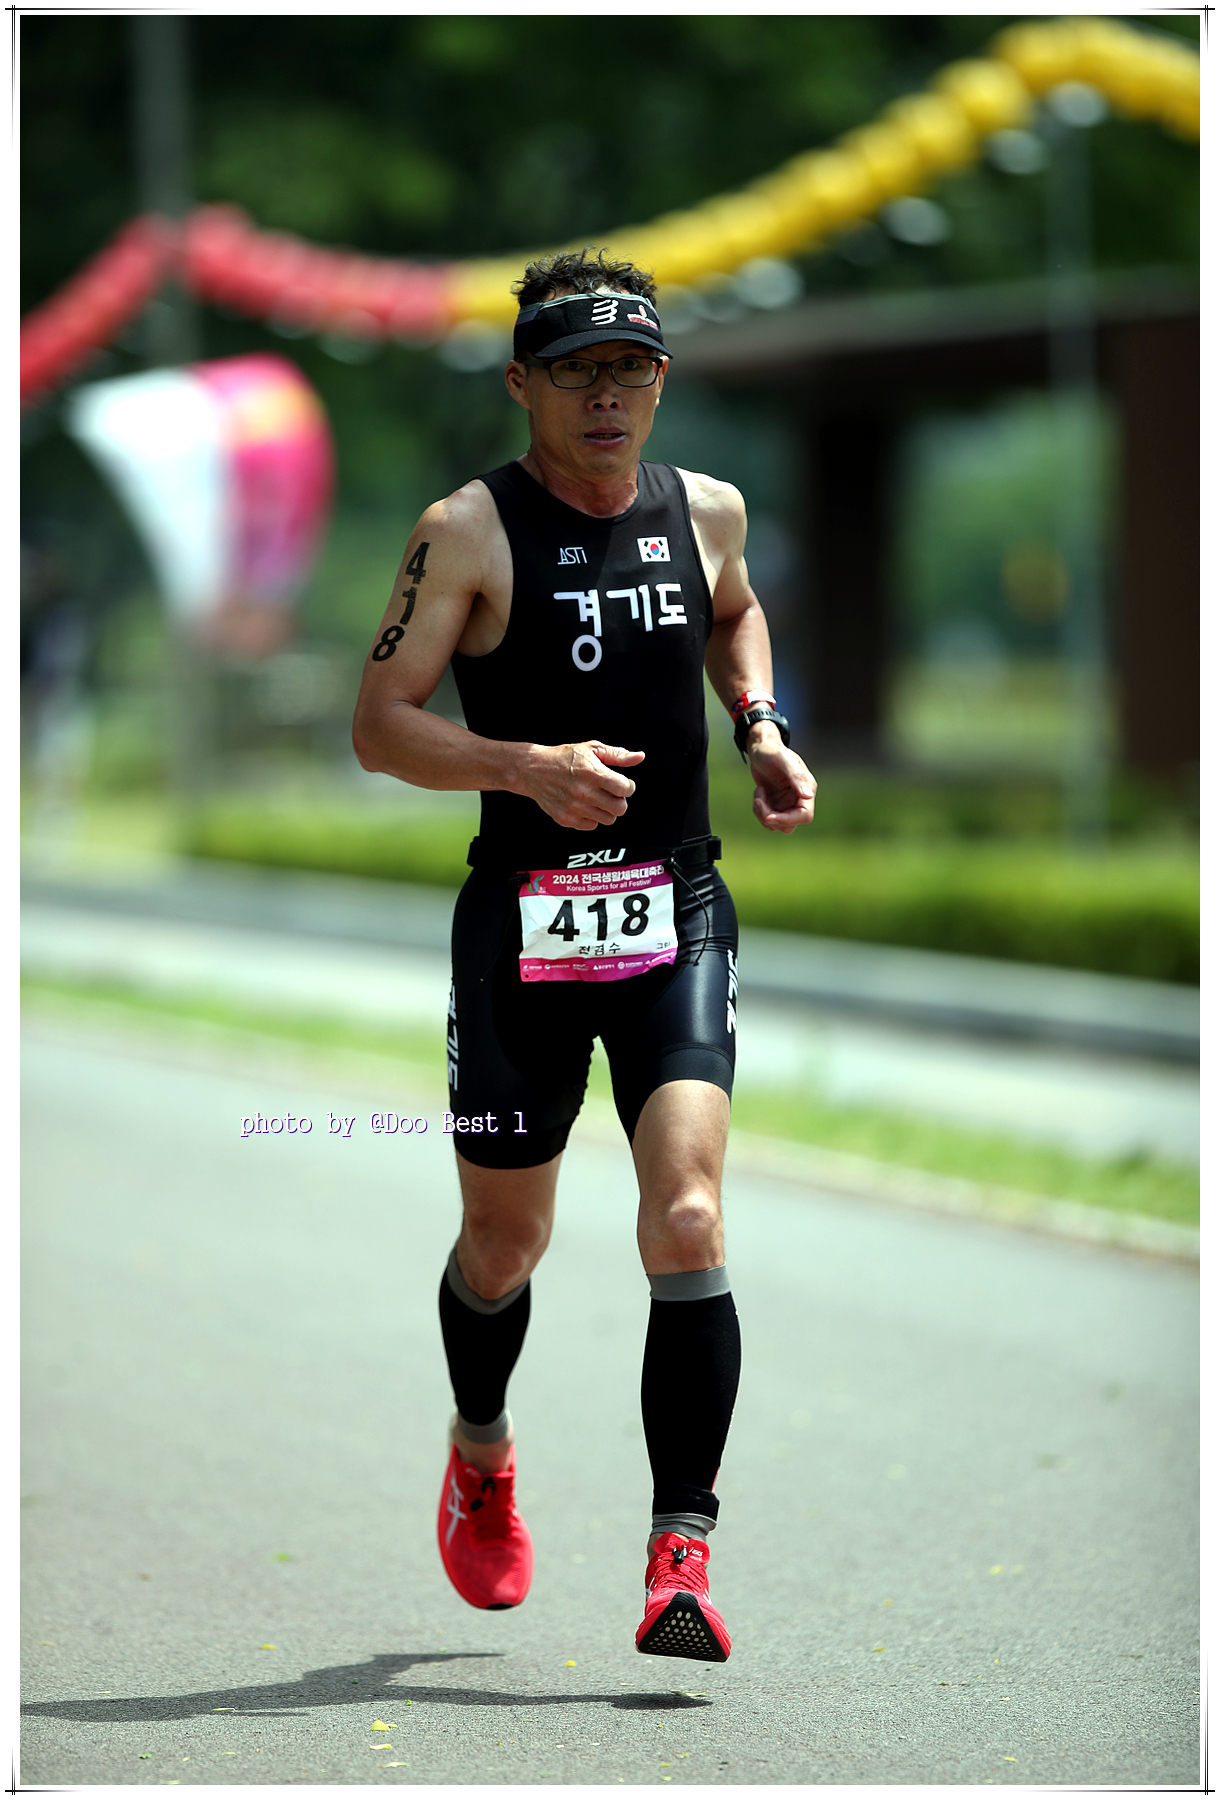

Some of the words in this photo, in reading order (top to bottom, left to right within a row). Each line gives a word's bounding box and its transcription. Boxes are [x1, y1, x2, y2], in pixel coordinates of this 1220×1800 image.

[372, 541, 430, 662] 418
[553, 583, 688, 672] 경기도
[567, 848, 626, 869] 2XU
[552, 874, 580, 885] 2024
[566, 884, 586, 892] Korea
[587, 883, 609, 892] Sports
[629, 877, 652, 887] Festival
[547, 893, 651, 941] 418
